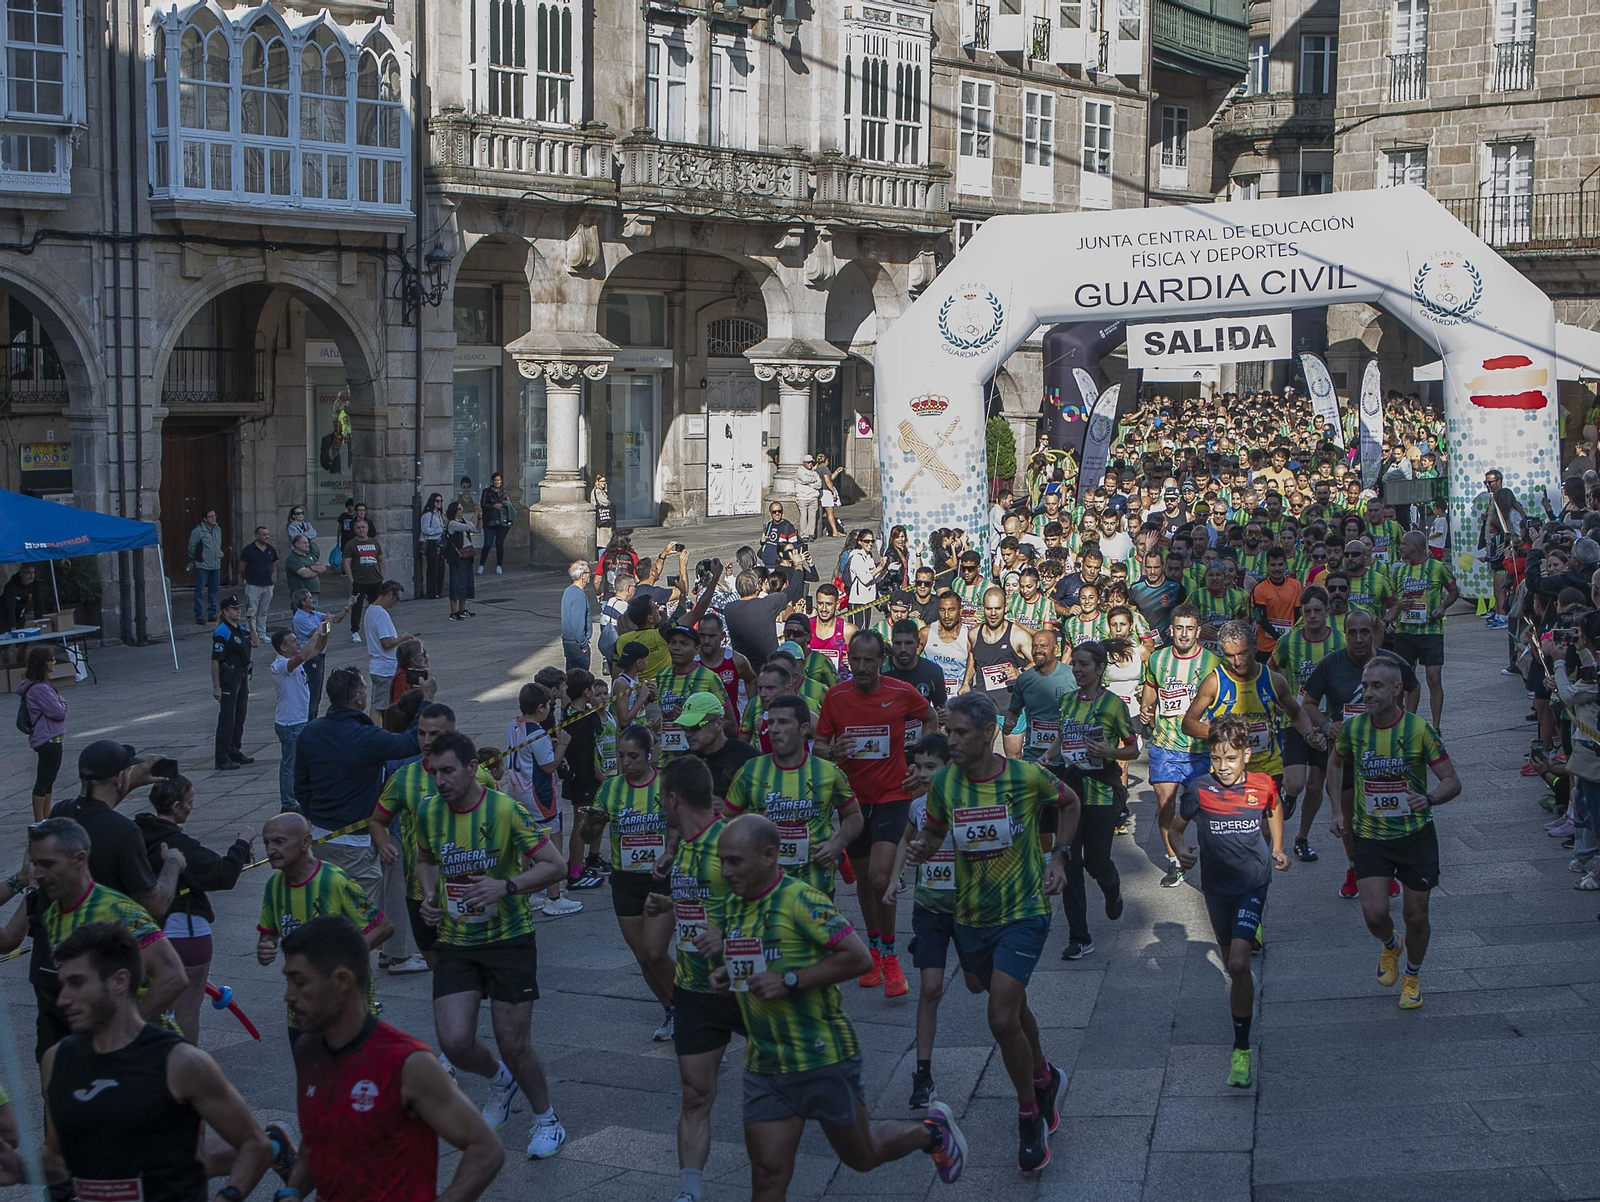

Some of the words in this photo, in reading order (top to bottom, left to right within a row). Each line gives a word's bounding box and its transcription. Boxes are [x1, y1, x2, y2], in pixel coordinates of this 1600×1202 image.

[1076, 233, 1133, 250] JUNTA
[1137, 228, 1218, 246] CENTRAL
[1222, 225, 1246, 239] DE
[1251, 215, 1354, 237] EDUCACIÓN
[1132, 250, 1185, 268] FÍSICA
[1190, 250, 1200, 263] Y
[1207, 241, 1299, 263] DEPORTES
[1074, 273, 1251, 308] GUARDIA
[1260, 264, 1358, 295] CIVIL
[1420, 309, 1460, 326] GUARDIA
[1461, 309, 1483, 324] CIVIL
[1144, 324, 1276, 356] SALIDA
[941, 343, 980, 358] GUARDIA
[980, 339, 1000, 354] CIVIL
[1406, 611, 1421, 619] 558
[1203, 641, 1218, 650] 671
[1164, 700, 1182, 709] 527
[665, 733, 681, 743] 233
[1037, 732, 1056, 740] 866
[1363, 758, 1404, 769] CARRERA
[766, 799, 813, 813] CARRERA
[1373, 797, 1399, 807] 180
[619, 812, 659, 826] CARRERA
[799, 807, 820, 819] CIVIL
[647, 820, 667, 831] CIVIL
[966, 824, 998, 840] 636
[440, 842, 455, 855] 3ª
[442, 849, 487, 865] CARRERA
[631, 850, 656, 861] 624
[926, 865, 952, 878] 666
[732, 961, 755, 976] 337
